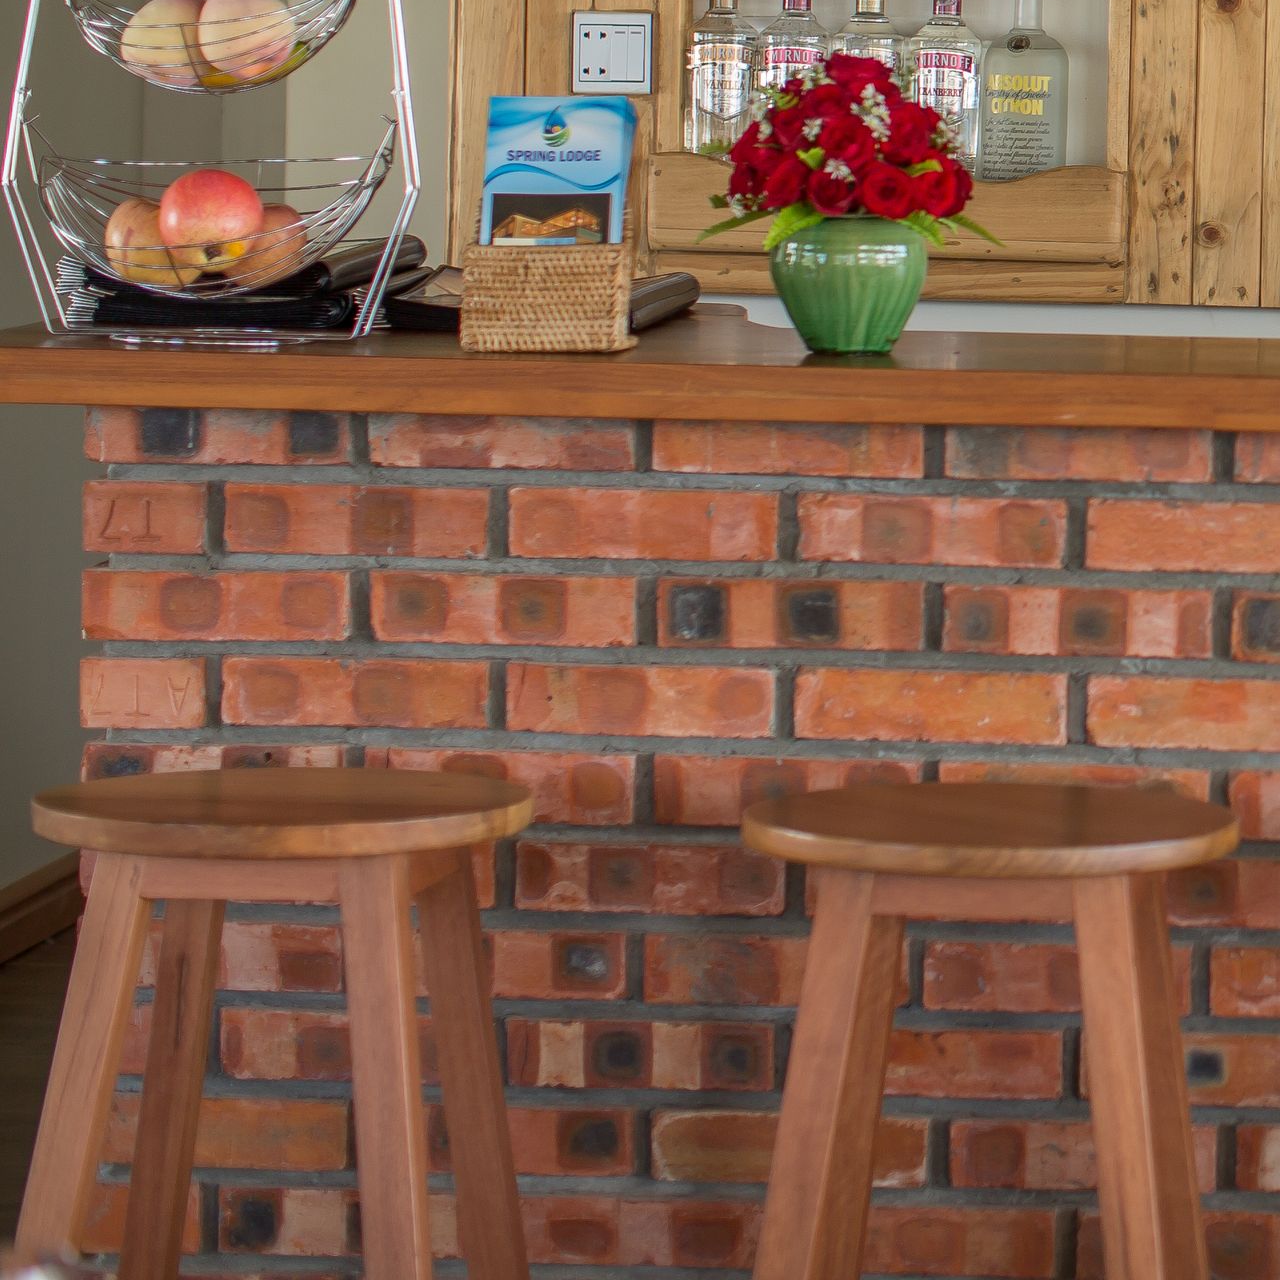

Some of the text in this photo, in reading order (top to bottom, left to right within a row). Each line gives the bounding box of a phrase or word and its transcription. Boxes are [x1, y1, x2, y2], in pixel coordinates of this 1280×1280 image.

[697, 46, 753, 62] SMIRNOFF
[988, 74, 1052, 93] ABSOLUT
[991, 98, 1044, 116] CITRON
[506, 149, 602, 162] SPRING LODGE
